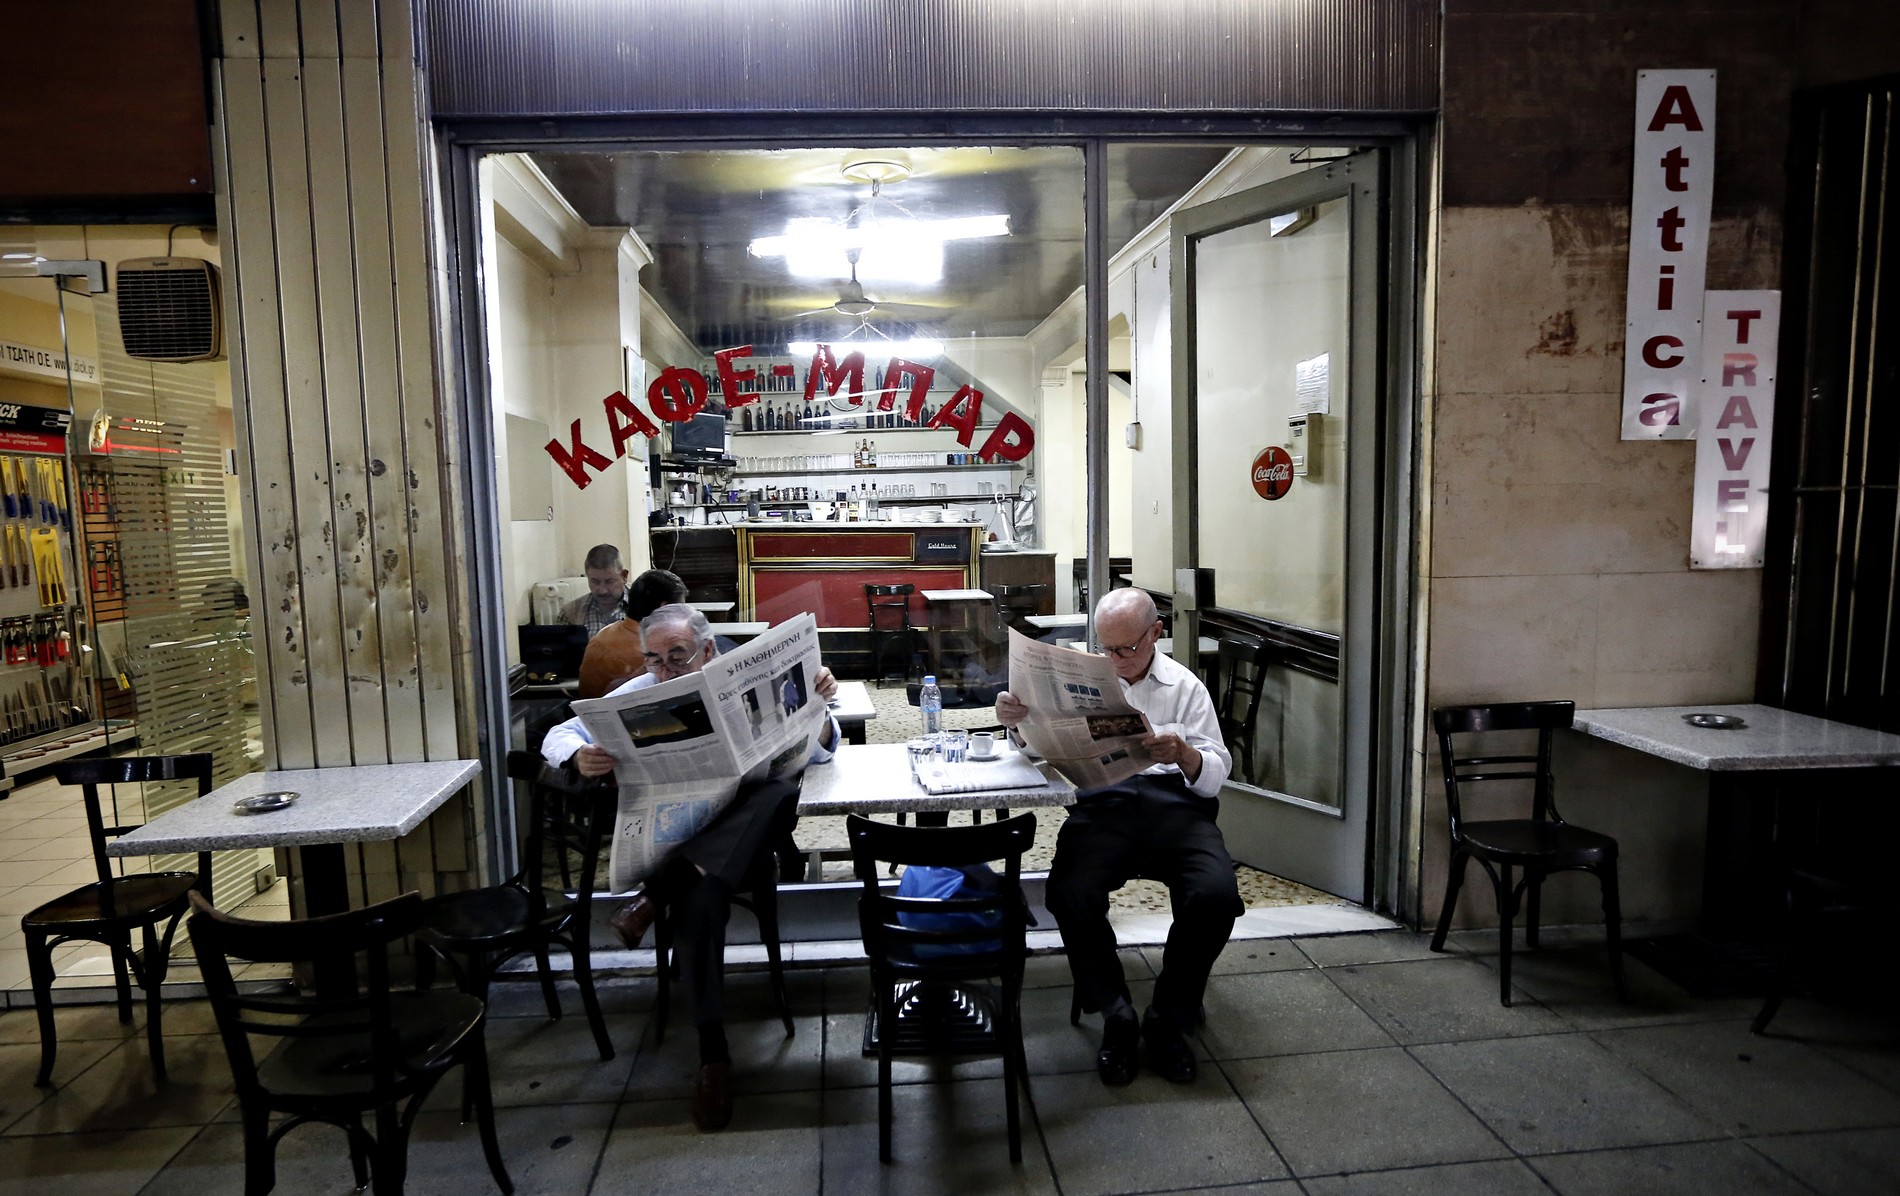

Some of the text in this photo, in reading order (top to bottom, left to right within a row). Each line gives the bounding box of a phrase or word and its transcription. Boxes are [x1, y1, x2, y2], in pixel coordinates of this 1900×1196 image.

[1639, 85, 1704, 426] Attica
[6, 345, 36, 365] ΤΣΑΤΗ
[54, 358, 95, 379] ww.dick.gr
[0, 403, 22, 418] CK
[1715, 310, 1762, 554] TRAVEL
[160, 472, 195, 484] EXIT
[1254, 463, 1290, 482] Coca-Cola
[743, 632, 801, 668] ΚΑΘΗΜΕΡΙΝΗ
